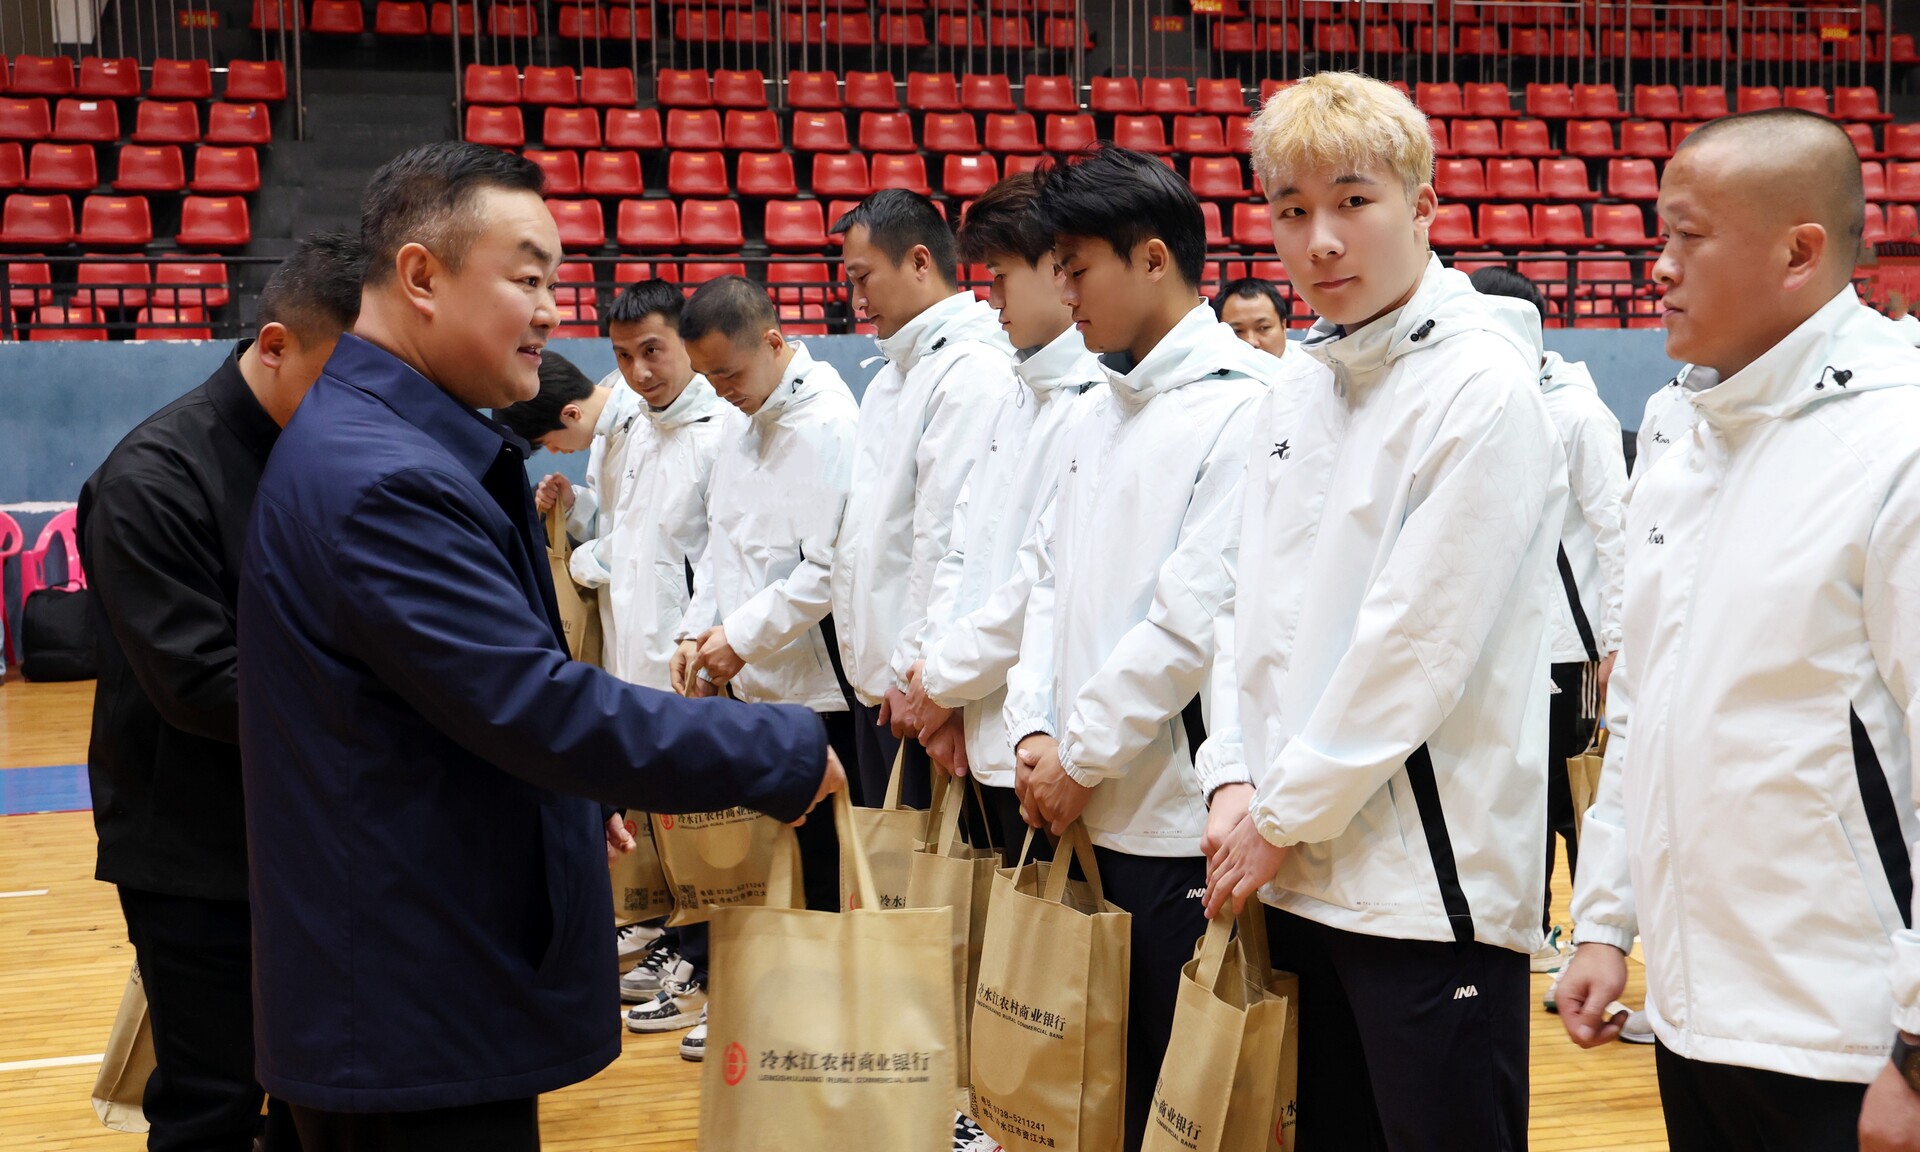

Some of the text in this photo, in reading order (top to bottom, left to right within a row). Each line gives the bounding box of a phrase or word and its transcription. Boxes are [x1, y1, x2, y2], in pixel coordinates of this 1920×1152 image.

[1453, 985, 1478, 1000] INA
[978, 982, 1066, 1032] 冷水江农村商业银行
[1017, 1020, 1048, 1036] COMMERCIAL
[1049, 1031, 1064, 1041] BANK
[759, 1049, 931, 1072] 冷水江农村商业银行
[1180, 1138, 1197, 1151] BANK
